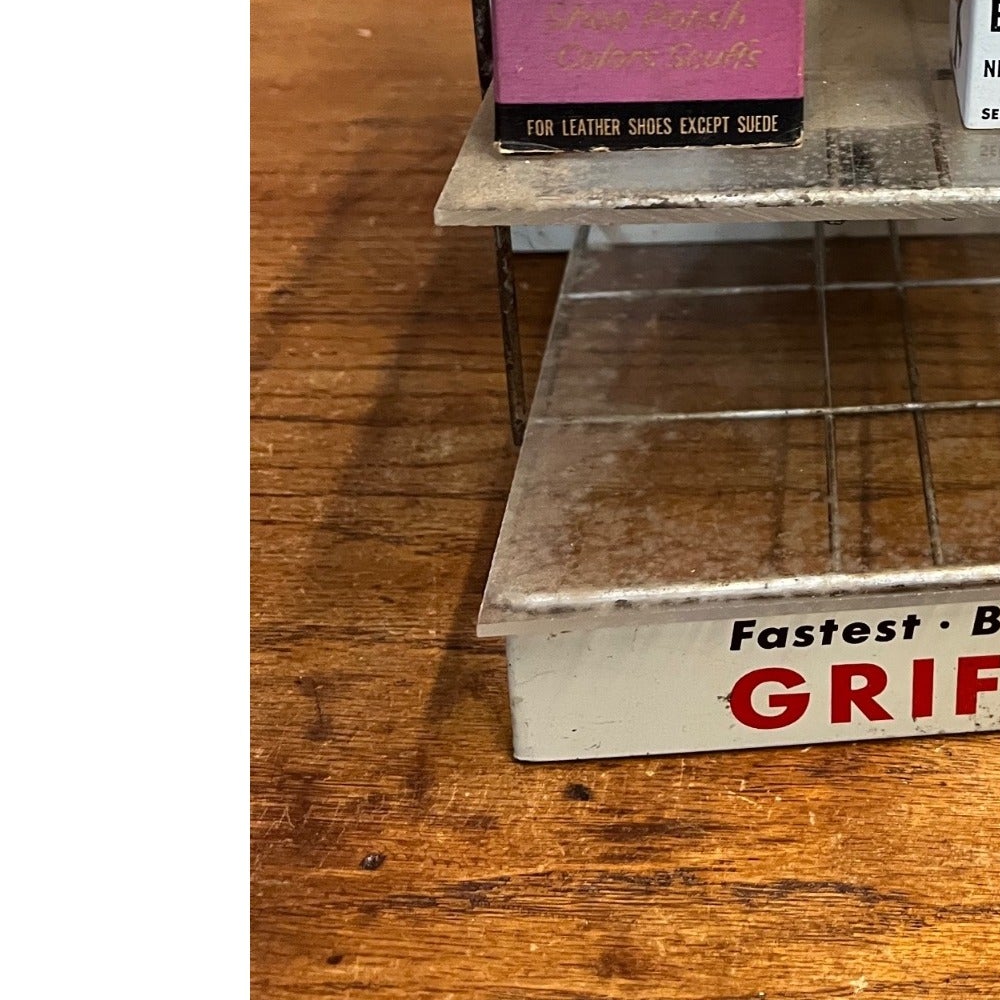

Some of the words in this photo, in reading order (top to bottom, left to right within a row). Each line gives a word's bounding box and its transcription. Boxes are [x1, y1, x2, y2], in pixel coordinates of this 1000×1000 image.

[527, 119, 554, 136] FOR
[562, 118, 621, 136] LEATHER
[628, 117, 673, 136] SHOES
[680, 116, 731, 135] EXCEPT
[737, 115, 779, 133] SUEDE
[729, 613, 921, 651] Fastest
